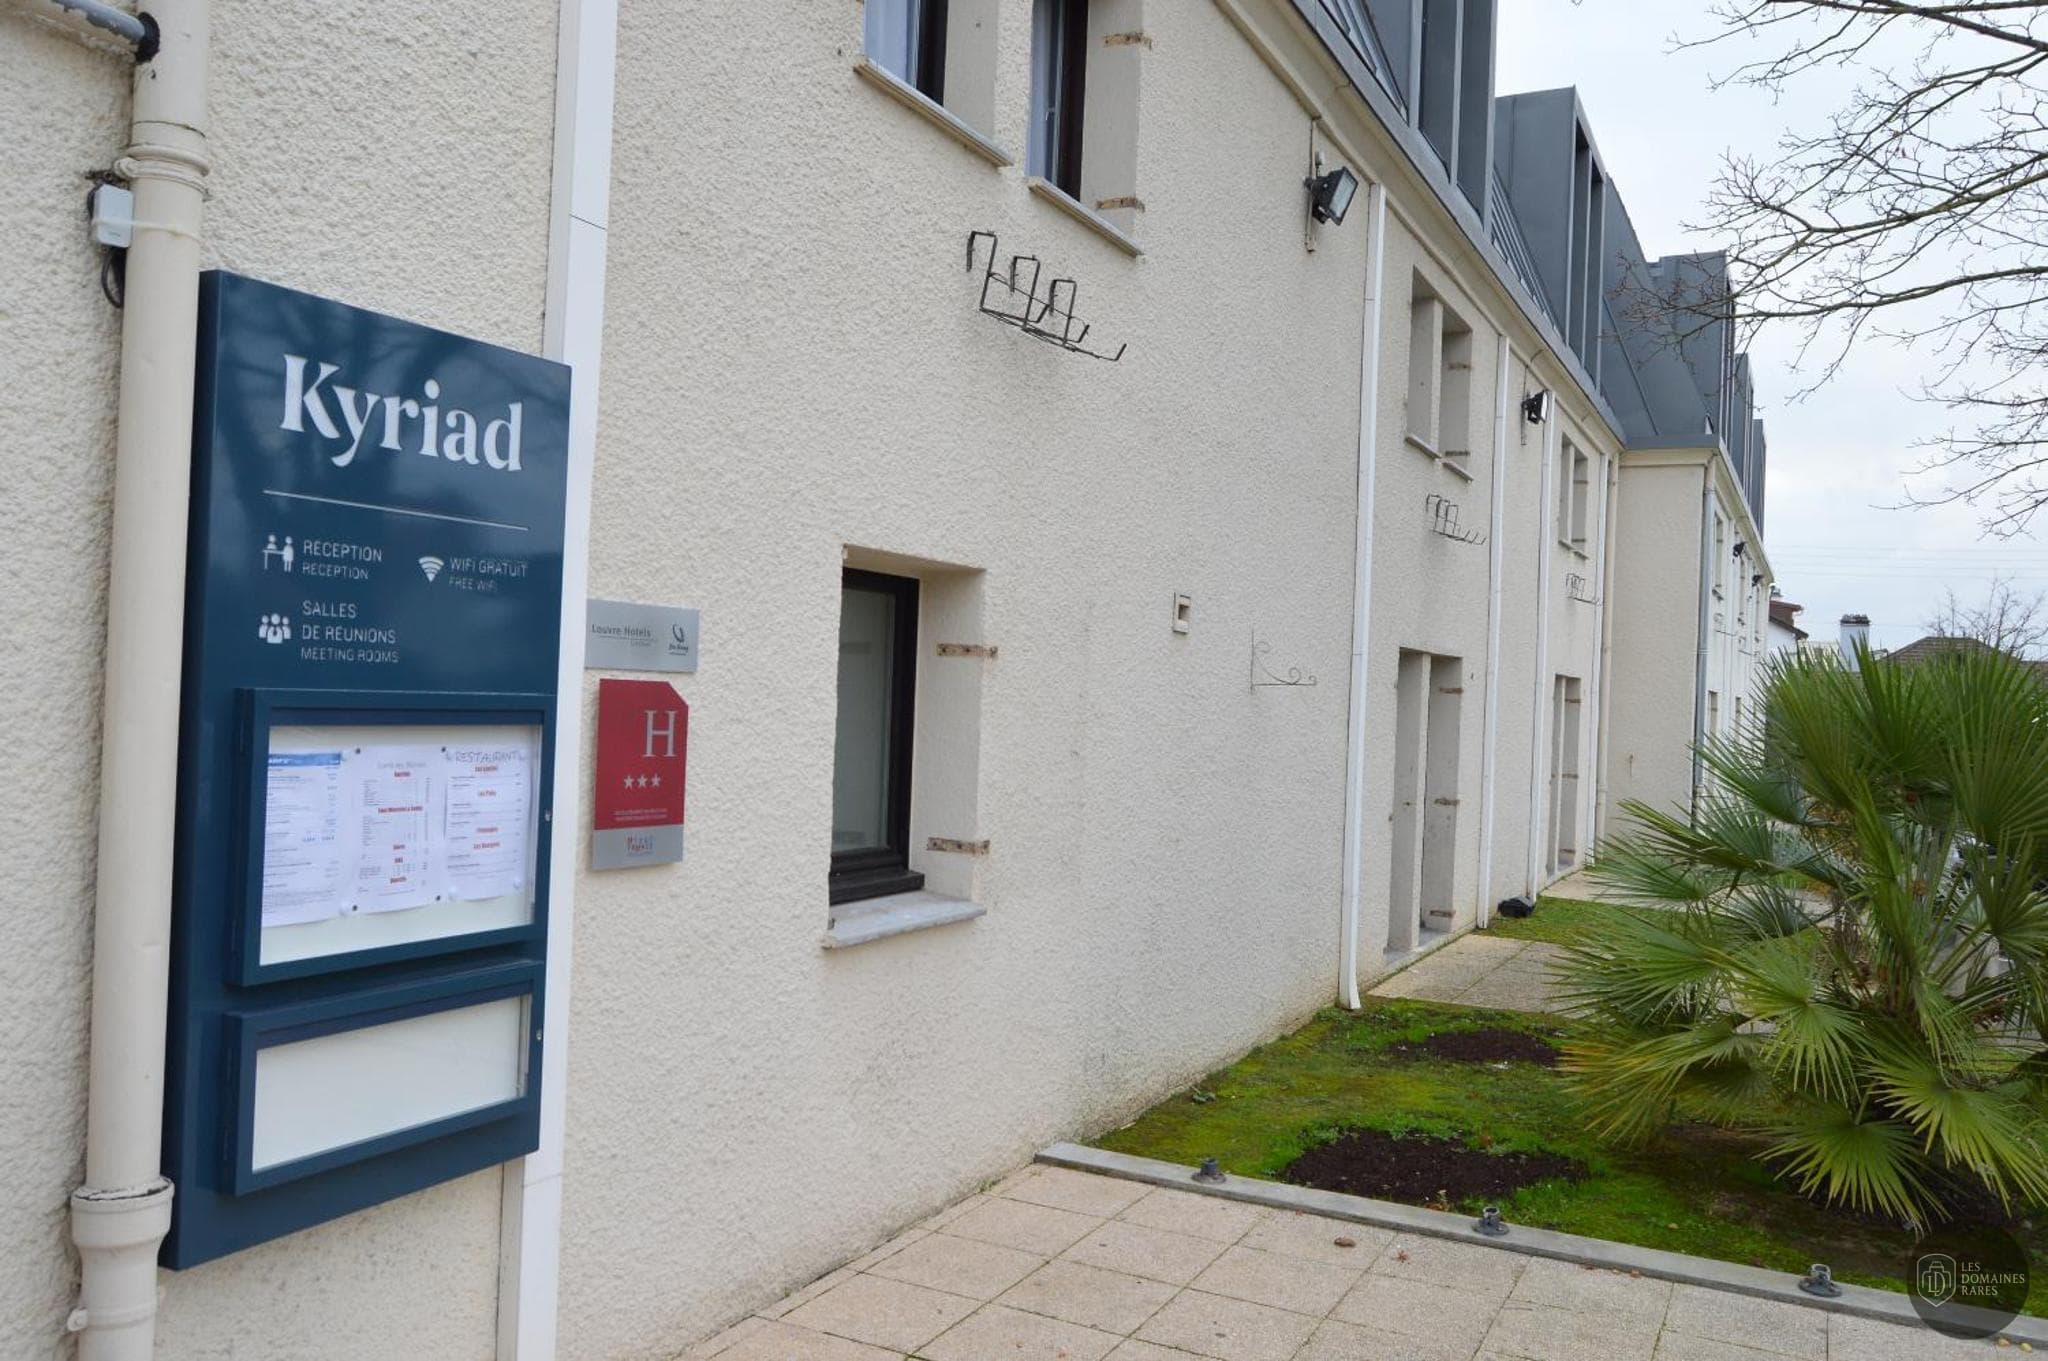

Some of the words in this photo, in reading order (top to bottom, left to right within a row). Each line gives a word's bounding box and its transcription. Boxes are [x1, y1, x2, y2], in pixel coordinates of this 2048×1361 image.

[279, 353, 523, 472] Kyriad
[302, 562, 369, 580] RECEPTION
[478, 559, 529, 577] GRATUIT
[448, 576, 473, 590] FREE
[302, 599, 358, 619] SALLES
[302, 624, 321, 640] DE
[591, 623, 622, 636] Louvre
[624, 624, 651, 638] Hotels
[300, 646, 355, 661] MEETING
[357, 649, 400, 663] ROOMS
[642, 709, 678, 758] H
